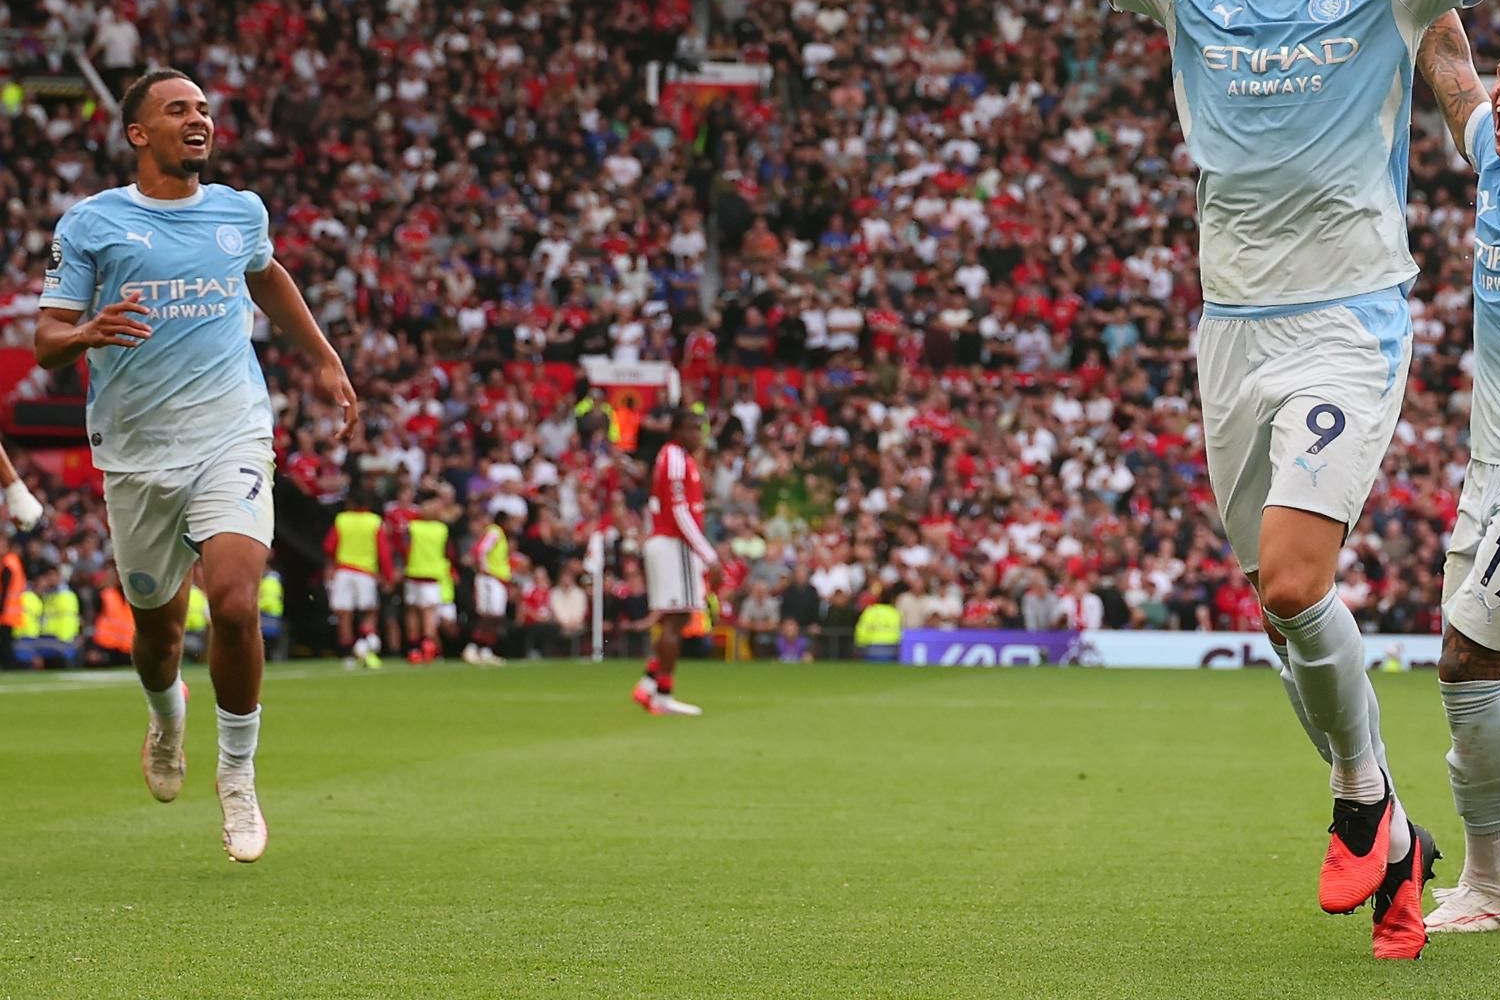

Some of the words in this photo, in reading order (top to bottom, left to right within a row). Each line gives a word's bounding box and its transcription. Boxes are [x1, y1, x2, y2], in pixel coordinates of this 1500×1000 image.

[1202, 37, 1360, 72] ETIHAD
[1228, 76, 1323, 97] AIRWAYS
[150, 302, 227, 319] AIRWAYS
[1306, 403, 1346, 455] 9
[240, 467, 263, 500] 7
